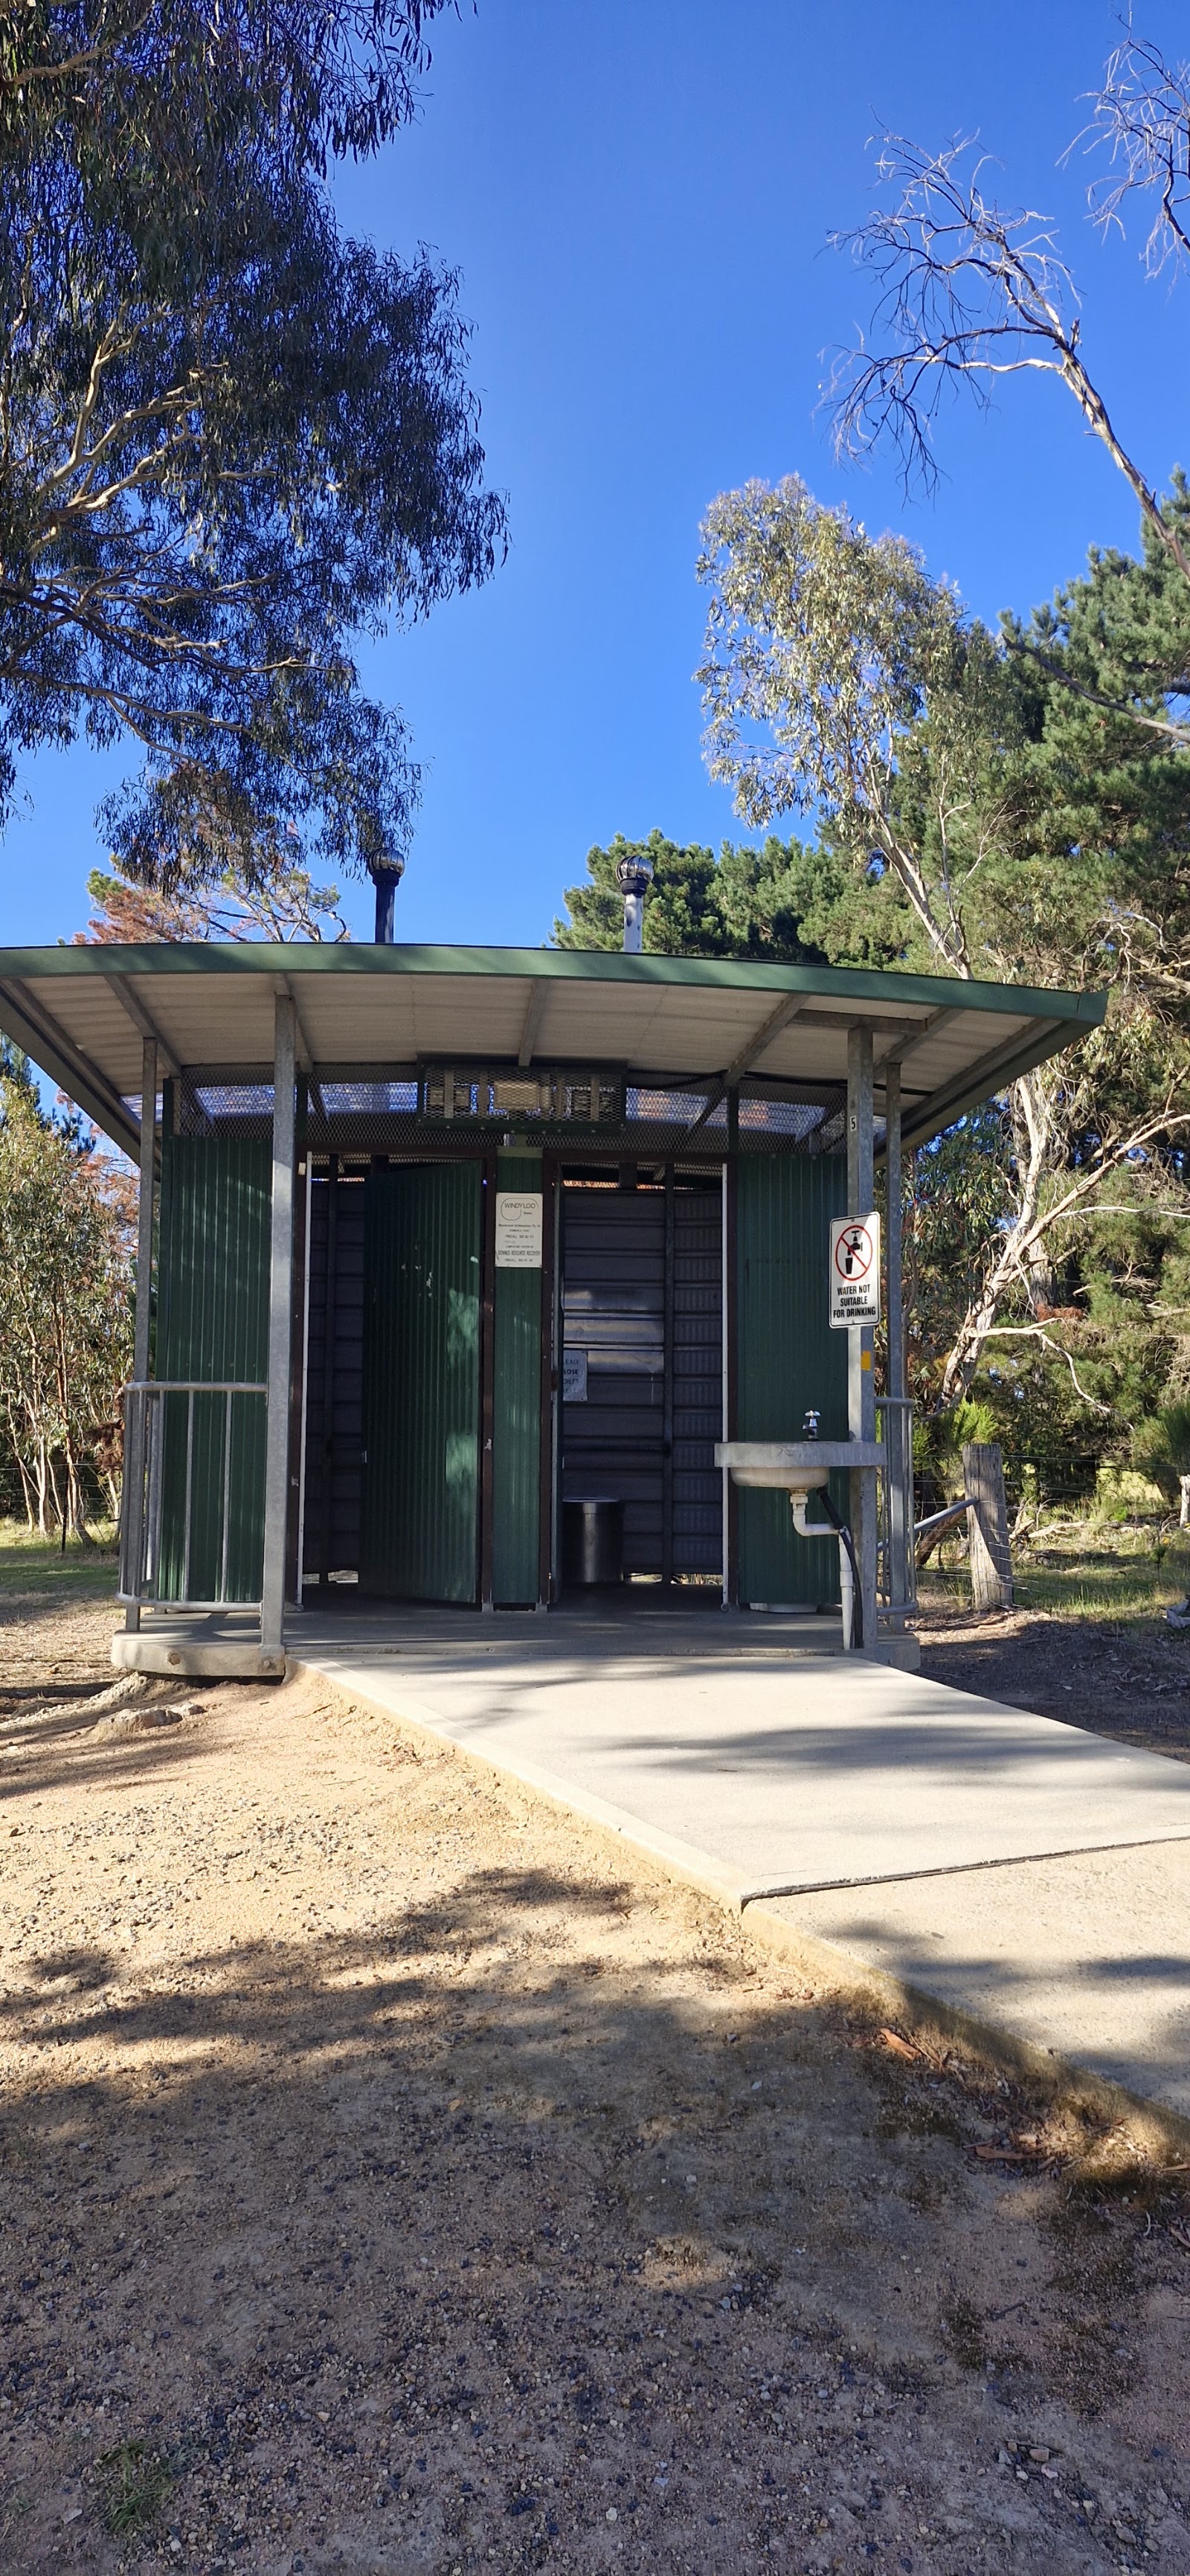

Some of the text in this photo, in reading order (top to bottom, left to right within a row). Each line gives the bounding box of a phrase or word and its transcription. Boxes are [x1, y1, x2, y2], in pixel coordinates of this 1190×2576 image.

[851, 1117, 855, 1129] 5
[837, 1284, 871, 1296] WATER NOT
[840, 1296, 868, 1306] SUITABLE
[833, 1306, 876, 1318] FOR DRINKING
